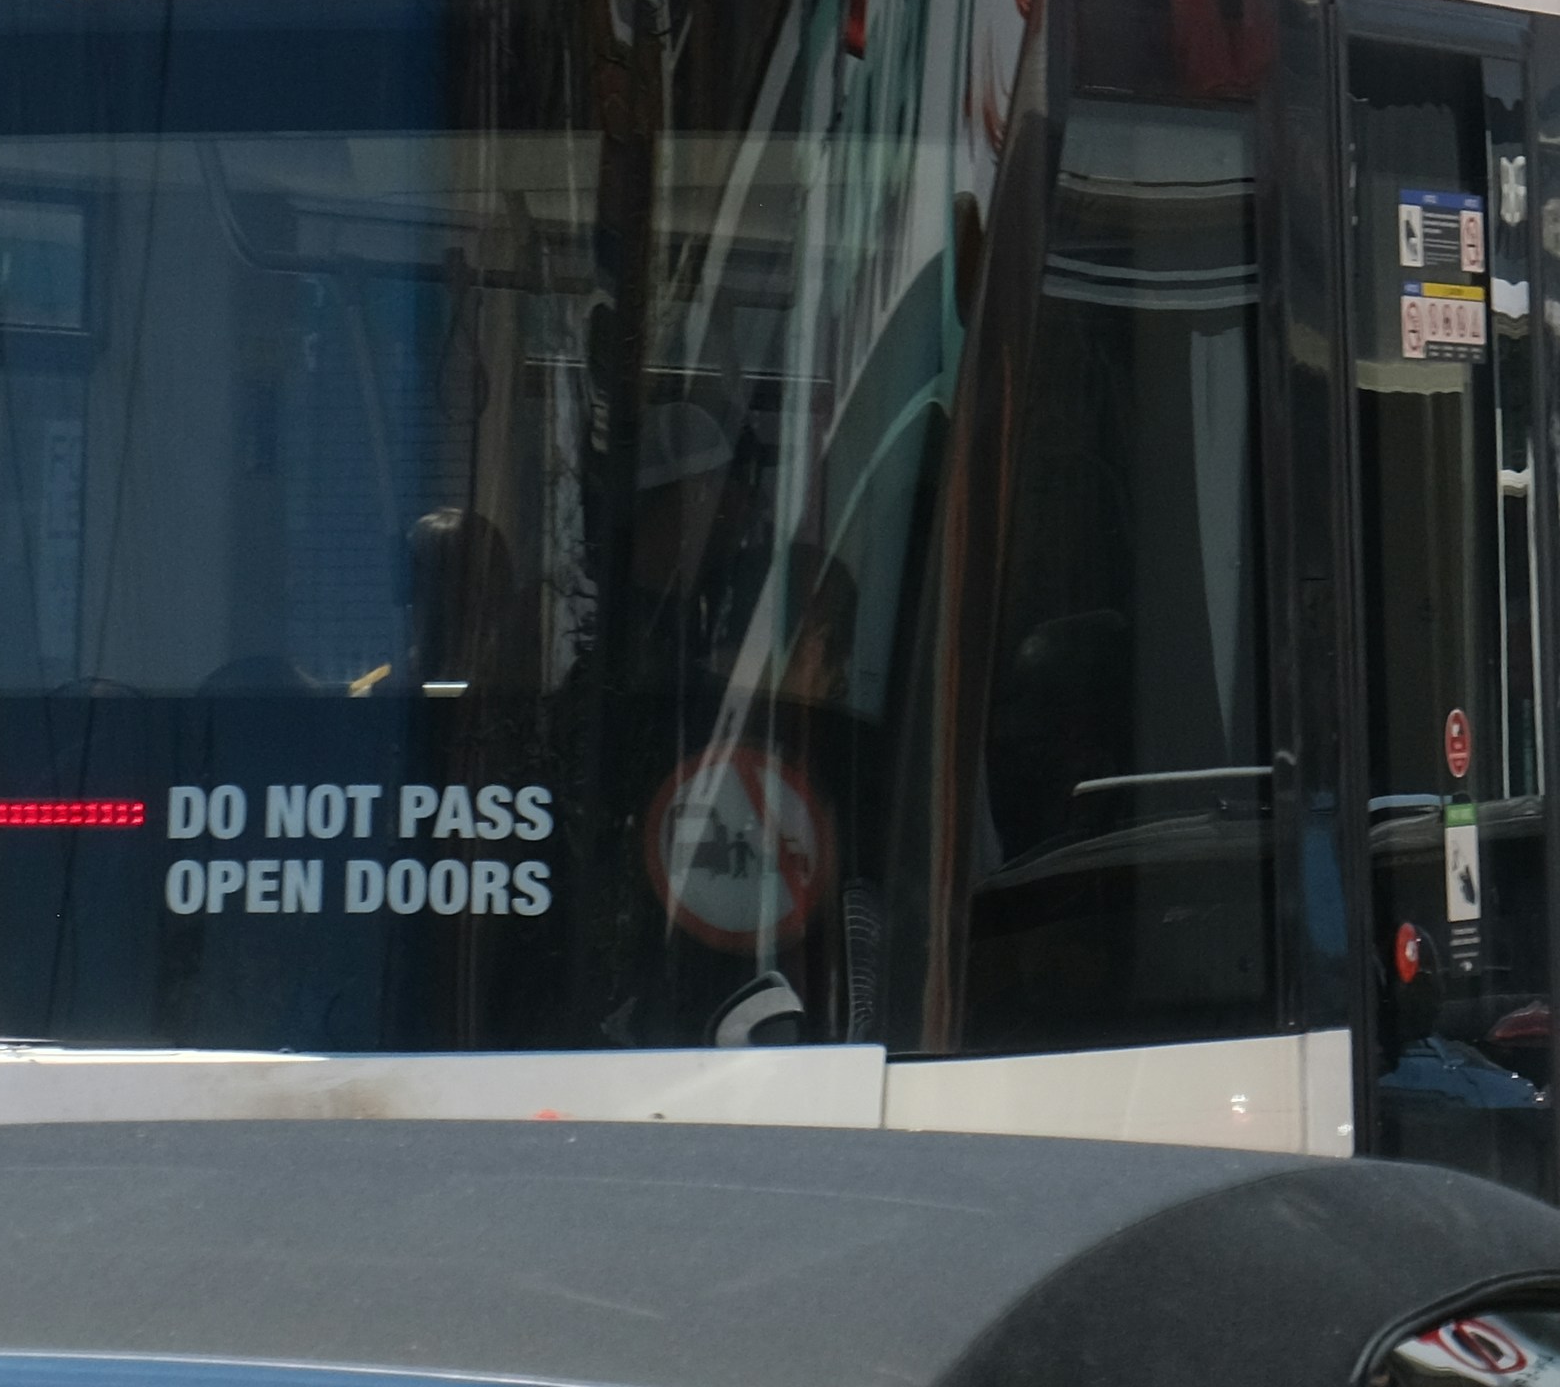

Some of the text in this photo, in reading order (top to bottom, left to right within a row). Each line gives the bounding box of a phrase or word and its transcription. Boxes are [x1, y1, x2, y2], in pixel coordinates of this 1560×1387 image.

[167, 784, 553, 840] DO NOT PASS
[166, 859, 552, 915] OPEN DOORS
